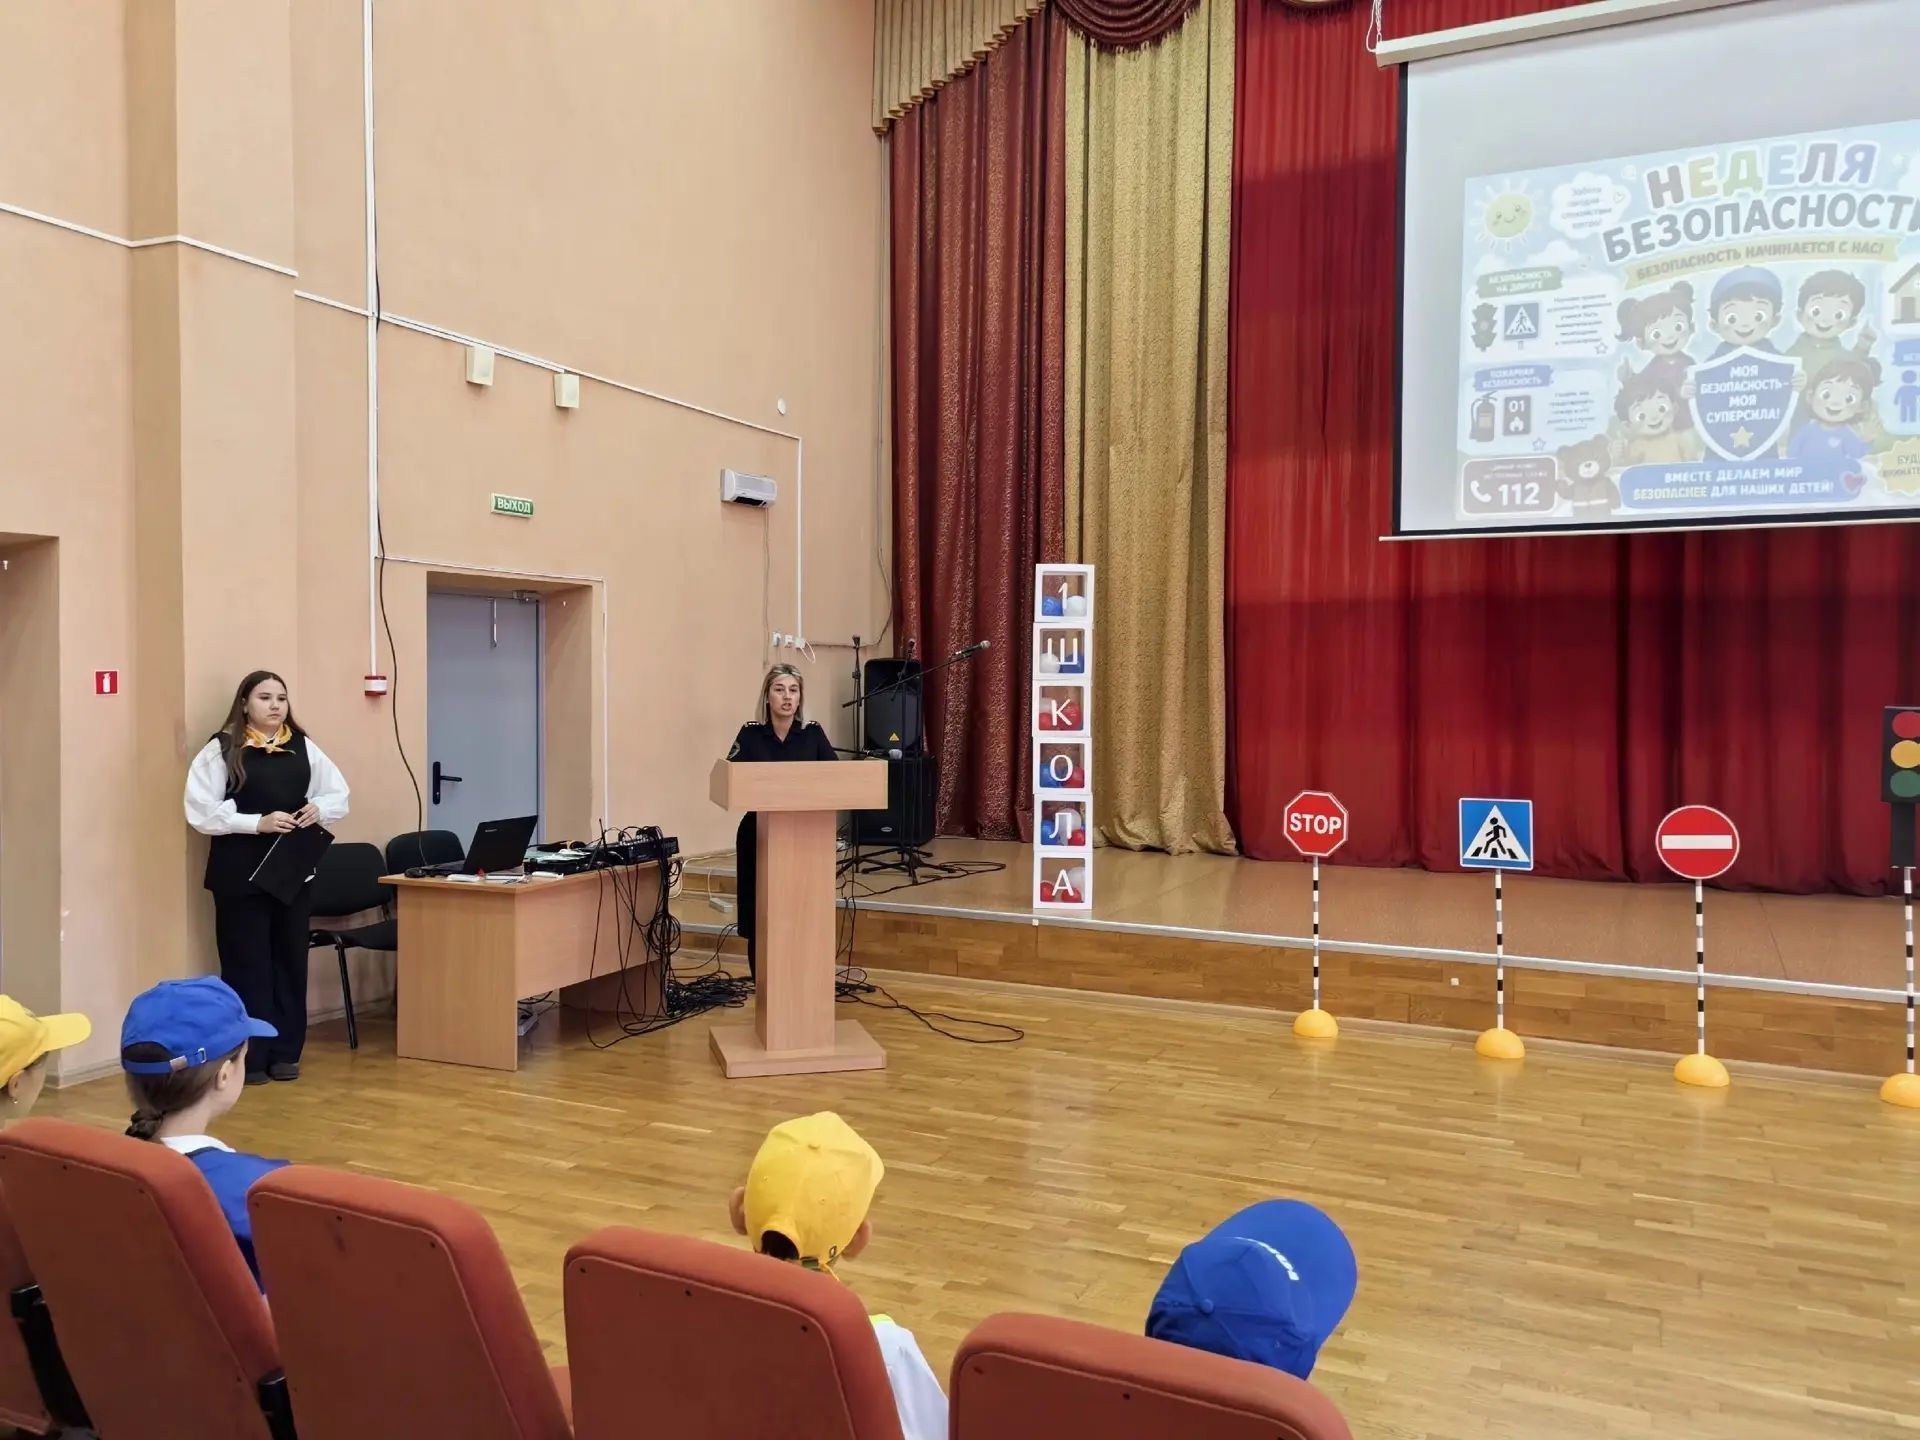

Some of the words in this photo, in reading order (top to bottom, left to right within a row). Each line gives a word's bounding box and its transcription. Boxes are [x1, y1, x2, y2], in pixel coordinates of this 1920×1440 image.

[1645, 143, 1878, 209] НЕДЕЛЯ
[1636, 248, 1741, 281] БЕЗОПАСНОСТЬ
[1745, 239, 1835, 260] НАЧИНАЕТСЯ
[1838, 241, 1848, 254] С
[1851, 242, 1885, 256] НАС!
[1730, 365, 1759, 378] МОЯ
[1509, 400, 1526, 412] 01
[1729, 394, 1757, 407] МОЯ
[1706, 408, 1780, 424] СУПЕРСИЛА!
[1664, 470, 1712, 483] ВМЕСТЕ
[1716, 468, 1770, 481] ДЕЛАЕМ
[1774, 466, 1803, 479] МИР
[1498, 481, 1540, 506] 112
[1633, 486, 1708, 501] БЕЗОПАСНЕЕ
[1710, 485, 1736, 498] ДЛЯ
[1740, 483, 1785, 497] НАШИХ
[1788, 480, 1834, 495] ДЕТЕЙ!
[497, 498, 531, 513] ВЫХОД
[1057, 582, 1069, 617] 1
[1290, 812, 1342, 835] STOP
